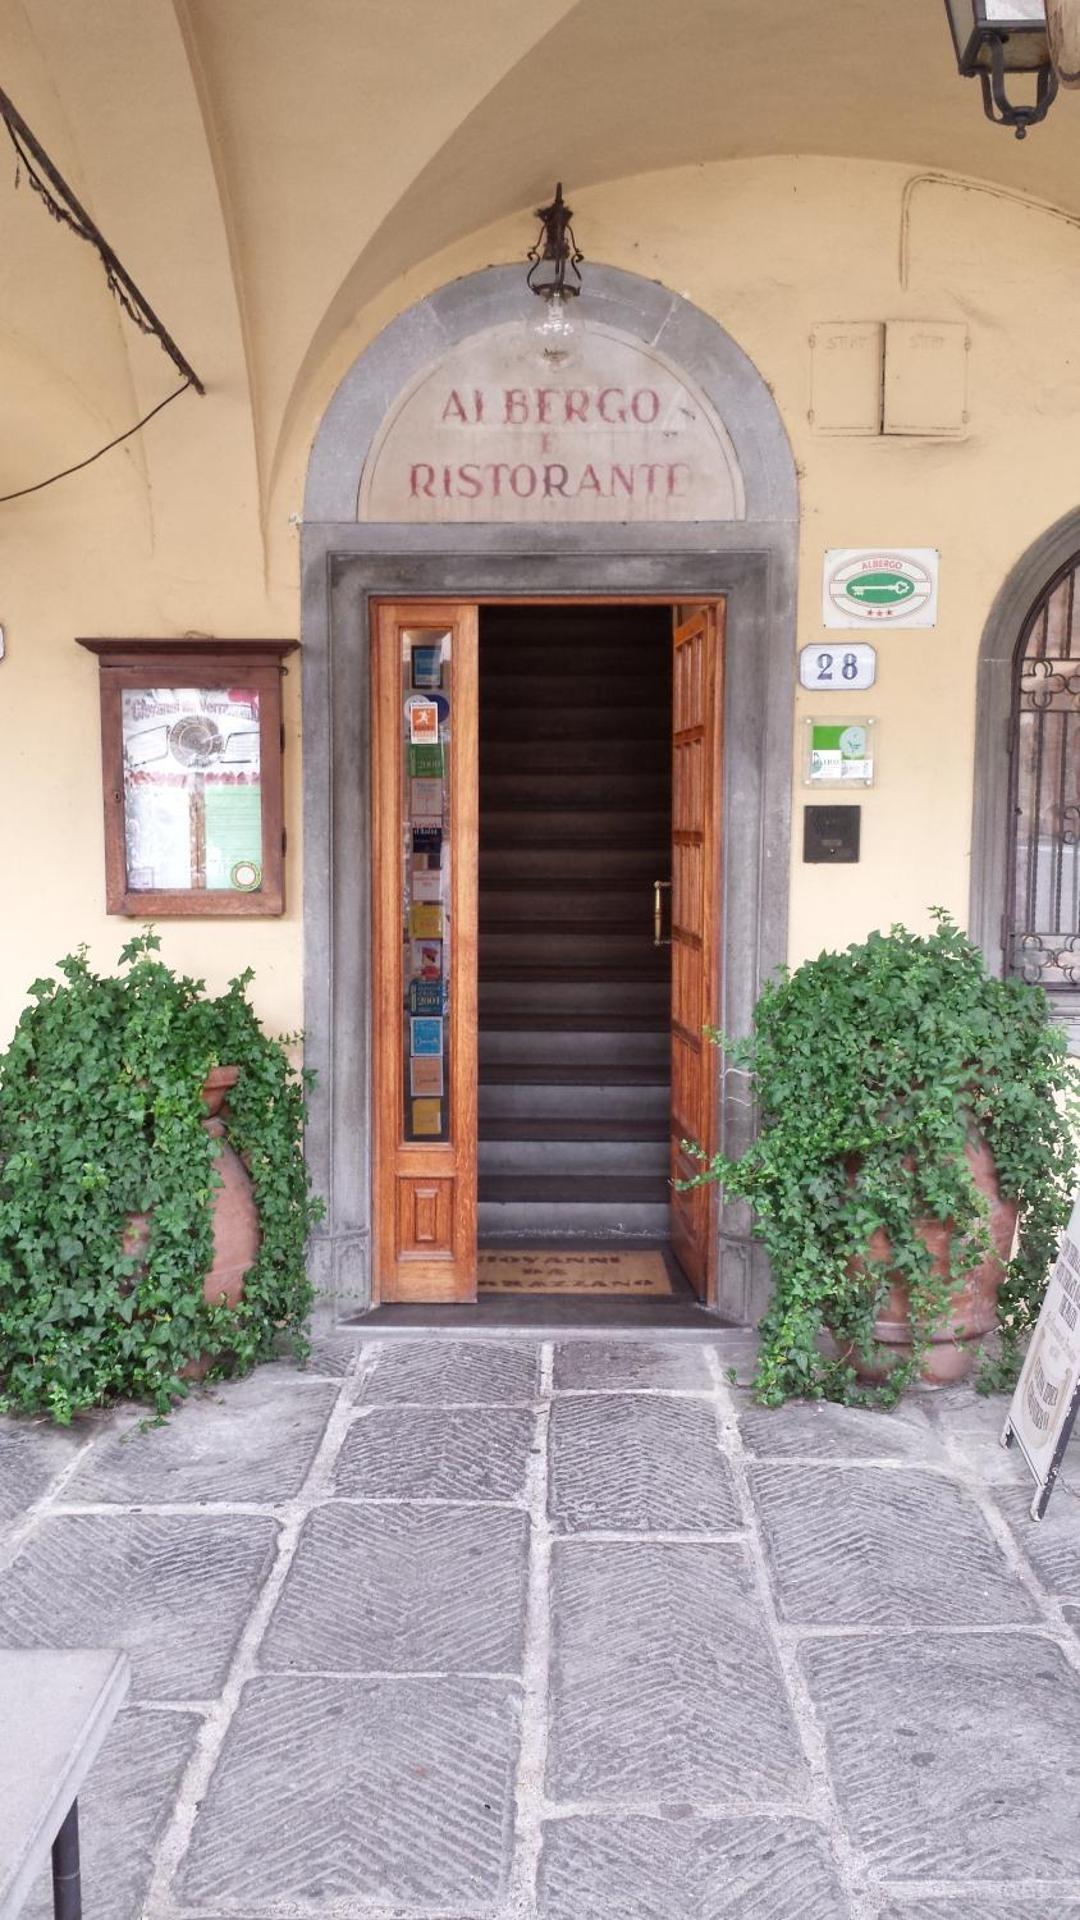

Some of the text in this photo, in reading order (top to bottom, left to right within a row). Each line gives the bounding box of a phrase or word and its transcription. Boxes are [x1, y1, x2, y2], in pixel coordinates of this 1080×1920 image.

[441, 388, 660, 425] ALBERGO
[408, 462, 690, 499] RISTORANTE
[862, 559, 903, 571] ALBERGO
[816, 653, 858, 681] 28
